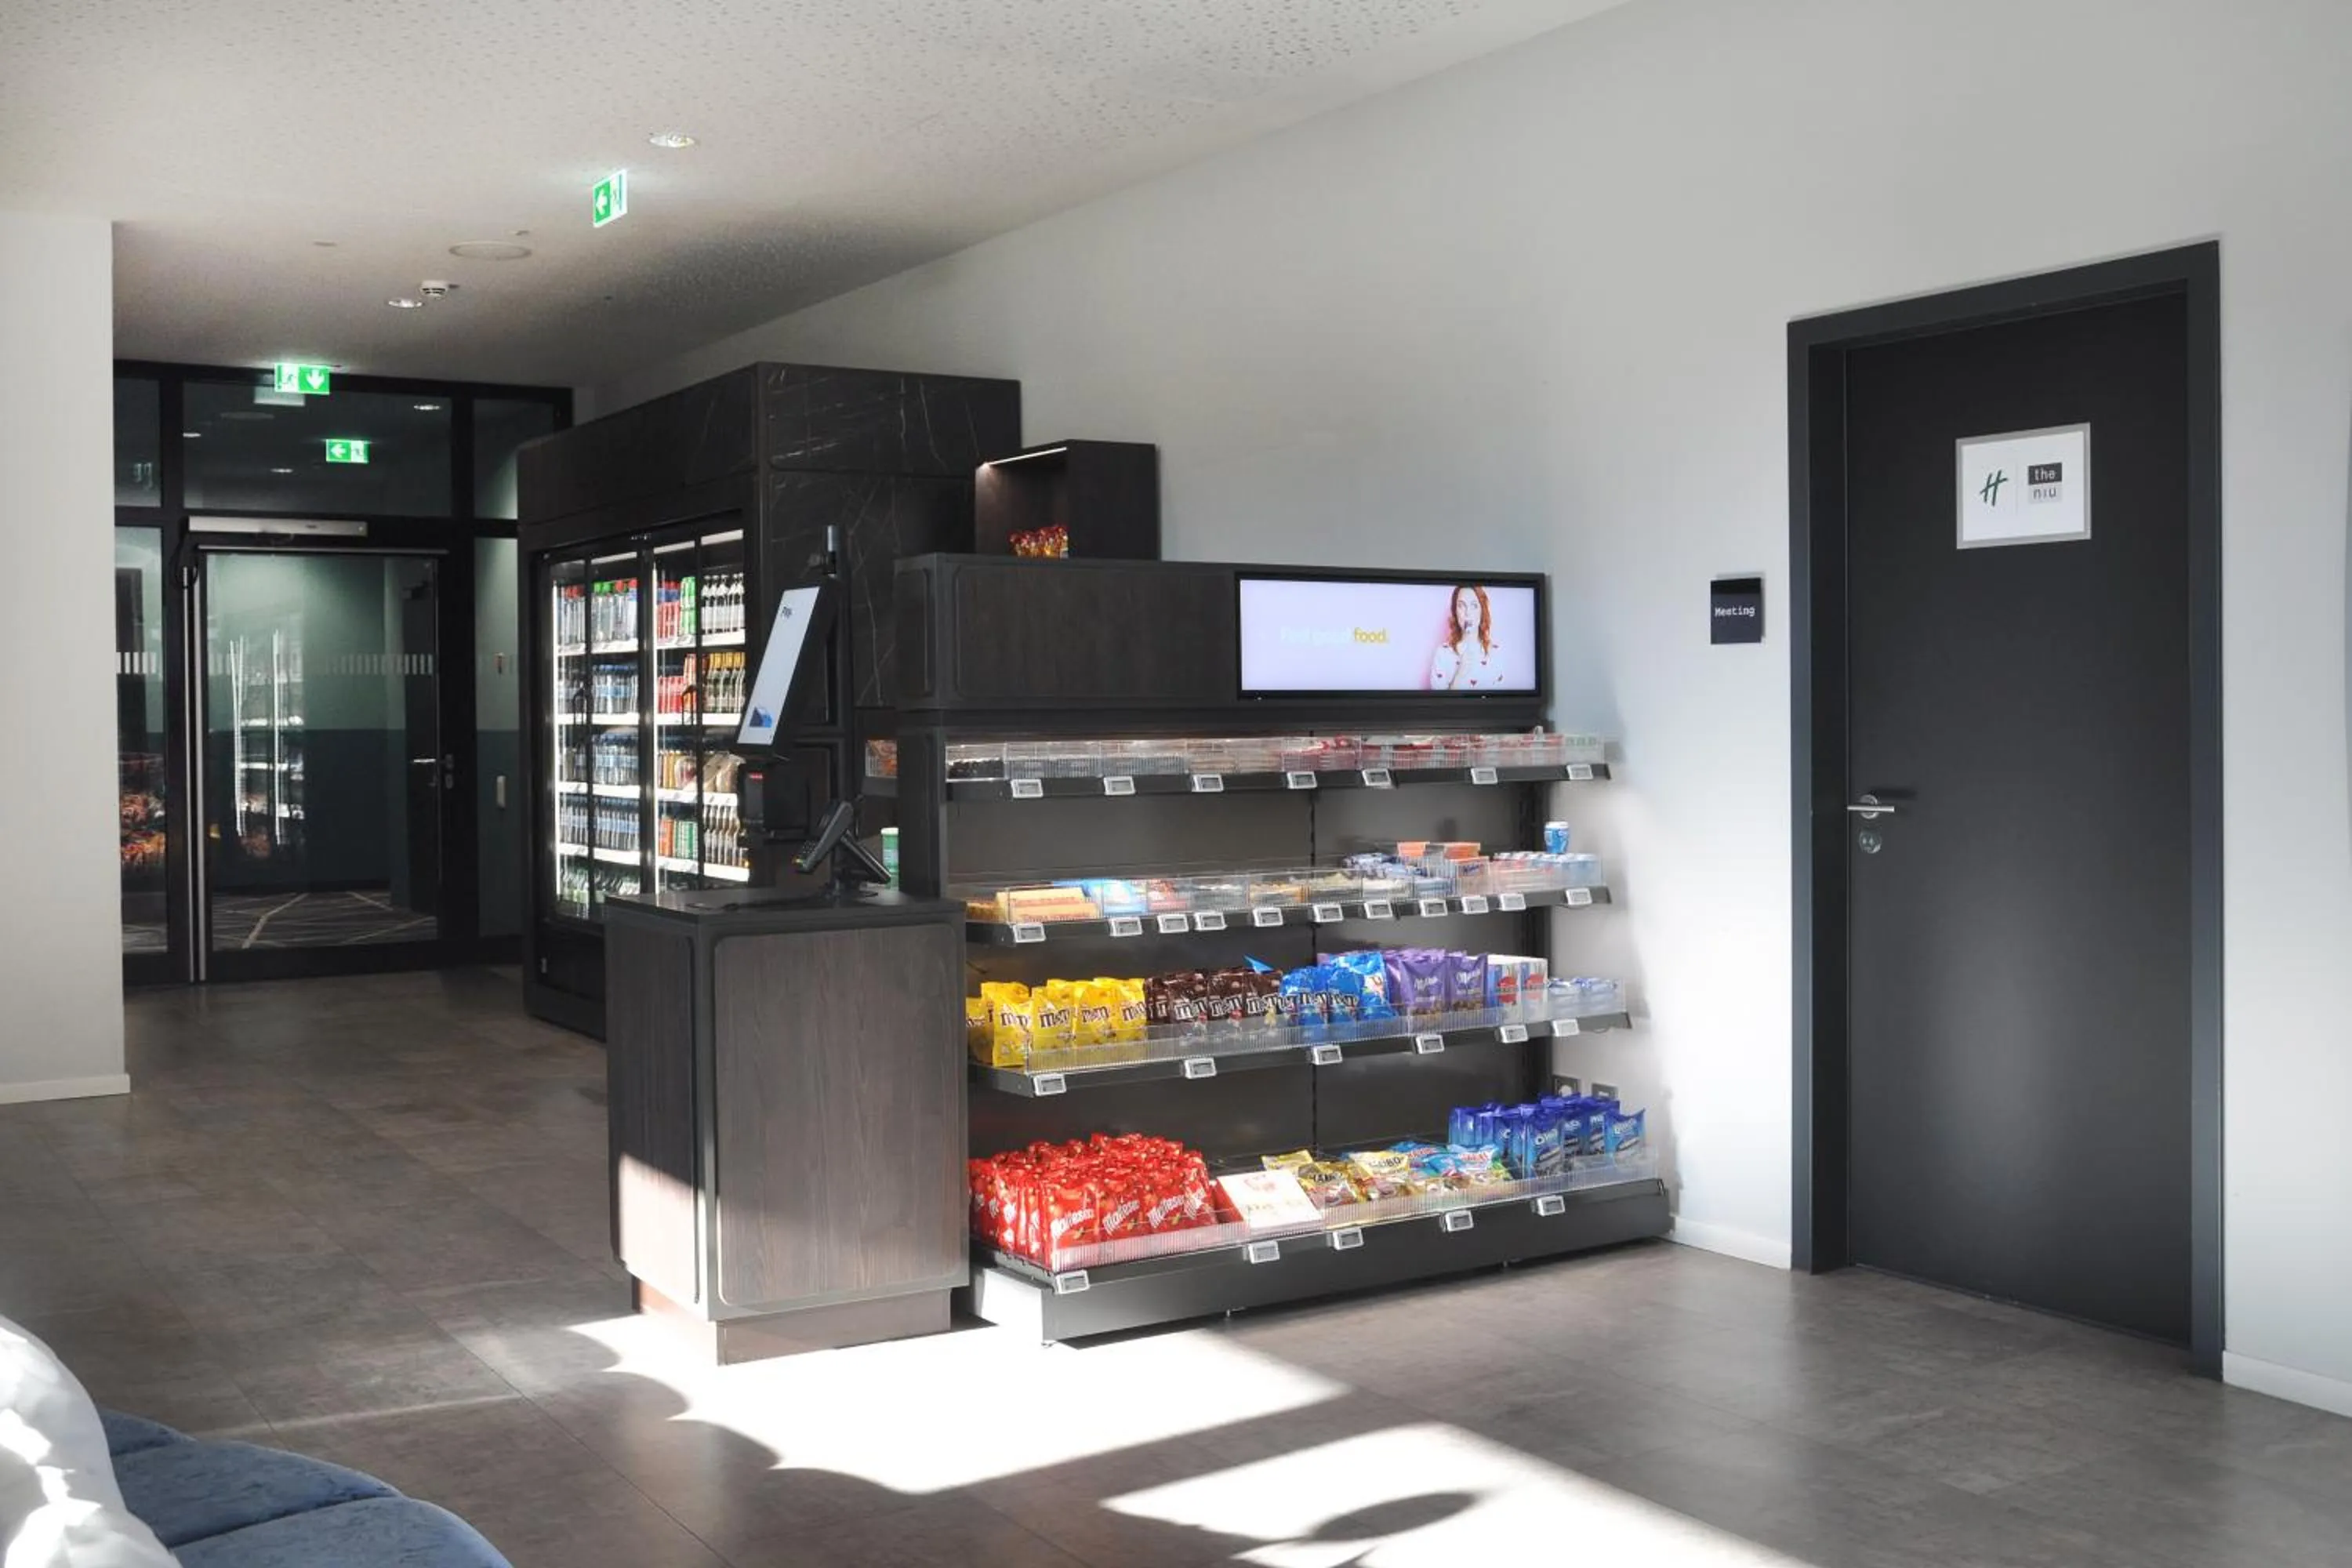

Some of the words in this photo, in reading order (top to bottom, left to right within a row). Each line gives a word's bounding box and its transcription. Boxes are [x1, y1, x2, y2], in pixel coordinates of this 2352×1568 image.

[2034, 468, 2056, 481] the
[1980, 470, 2008, 506] H
[2033, 487, 2056, 499] niu
[1714, 606, 1755, 617] Meeting
